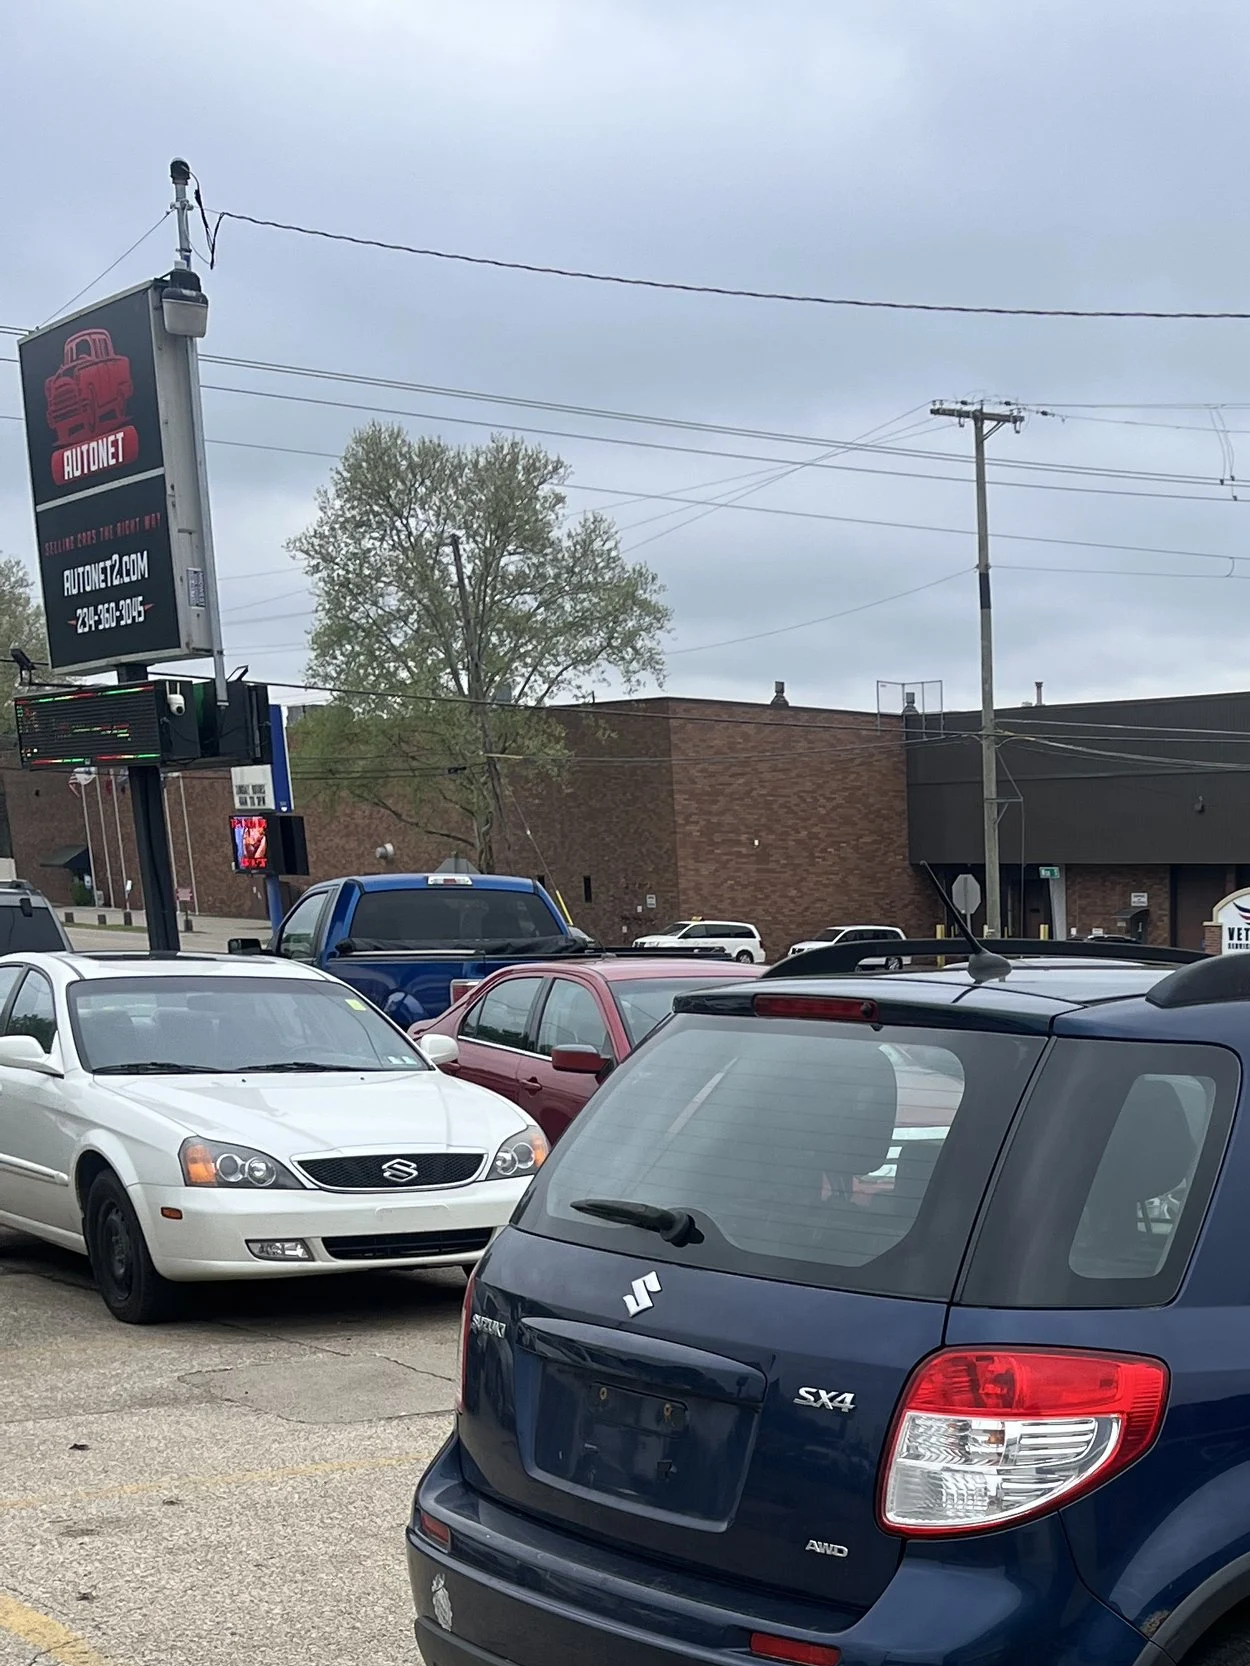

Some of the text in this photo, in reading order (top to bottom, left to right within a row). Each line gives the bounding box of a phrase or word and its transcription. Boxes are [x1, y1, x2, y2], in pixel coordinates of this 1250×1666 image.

[63, 431, 124, 480] AUTONET
[77, 529, 97, 549] CARS
[100, 524, 114, 542] THE
[117, 517, 140, 538] RIGHT
[143, 512, 161, 532] WAY
[63, 550, 149, 597] AUTONET2.COM
[76, 596, 145, 634] 234-360-3045
[793, 1386, 856, 1413] SX4
[805, 1539, 849, 1558] AWD
